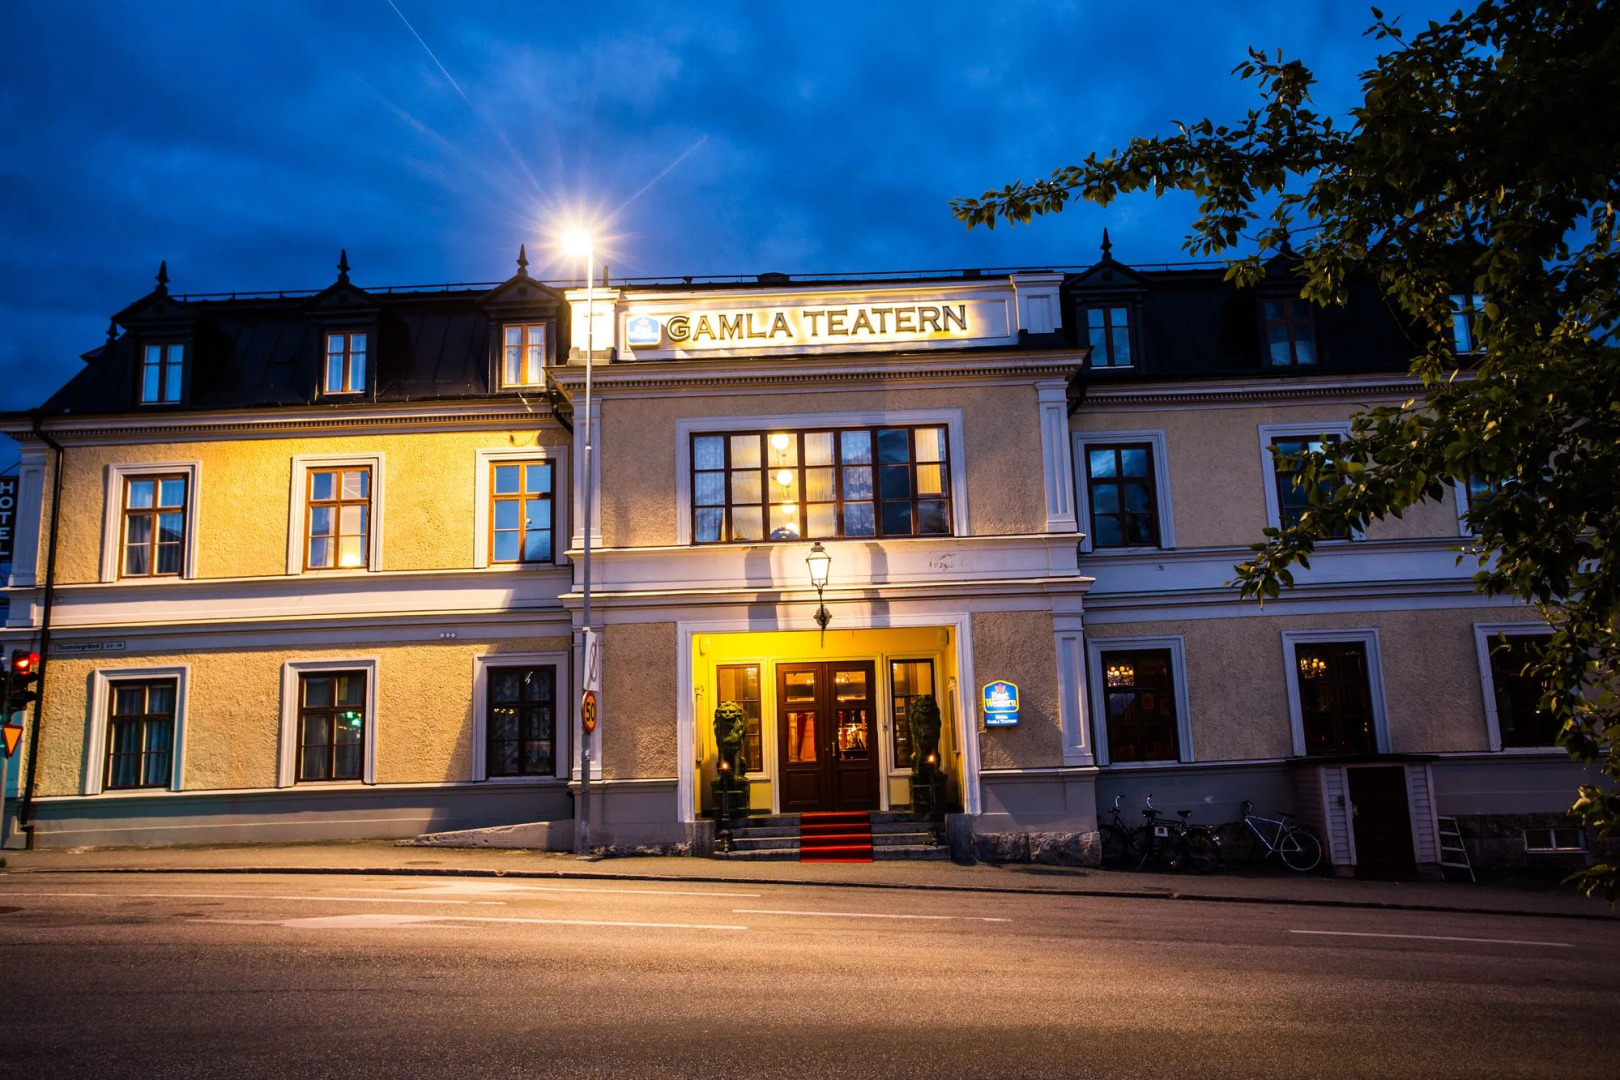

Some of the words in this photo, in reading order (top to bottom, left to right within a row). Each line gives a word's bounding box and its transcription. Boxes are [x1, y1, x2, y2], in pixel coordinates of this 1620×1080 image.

[666, 312, 793, 342] GAMLA
[803, 304, 968, 336] TEATERN
[991, 691, 1009, 700] Best
[985, 699, 1017, 708] Western
[586, 702, 595, 722] 50
